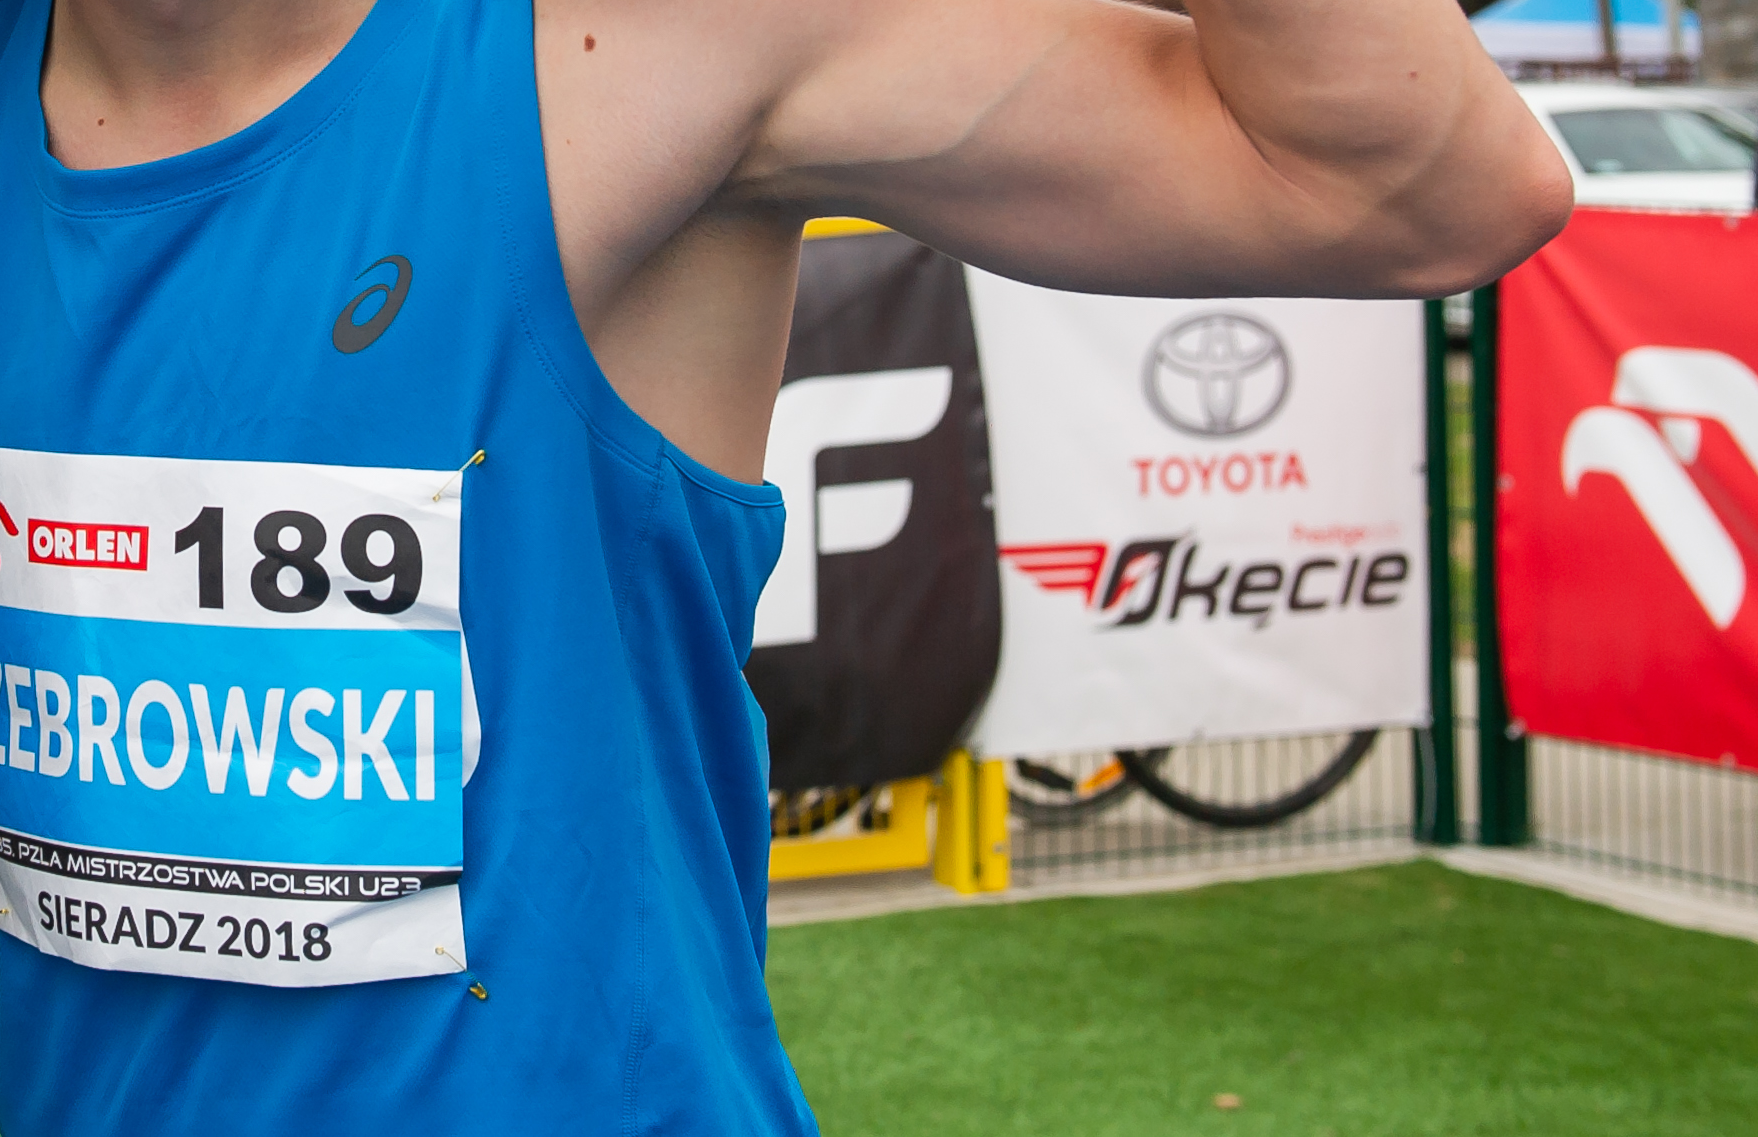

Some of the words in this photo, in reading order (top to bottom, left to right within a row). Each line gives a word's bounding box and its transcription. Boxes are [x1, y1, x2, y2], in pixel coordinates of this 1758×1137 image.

[1132, 452, 1308, 497] TOYOTA
[31, 526, 142, 564] ORLEN
[174, 506, 424, 615] 189
[18, 842, 63, 870] PZLA
[66, 855, 245, 891] MISTRZOSTWA
[250, 874, 350, 898] POLSKI
[358, 877, 422, 897] U23
[38, 891, 206, 954] SIERADZ
[217, 915, 333, 963] 2018
